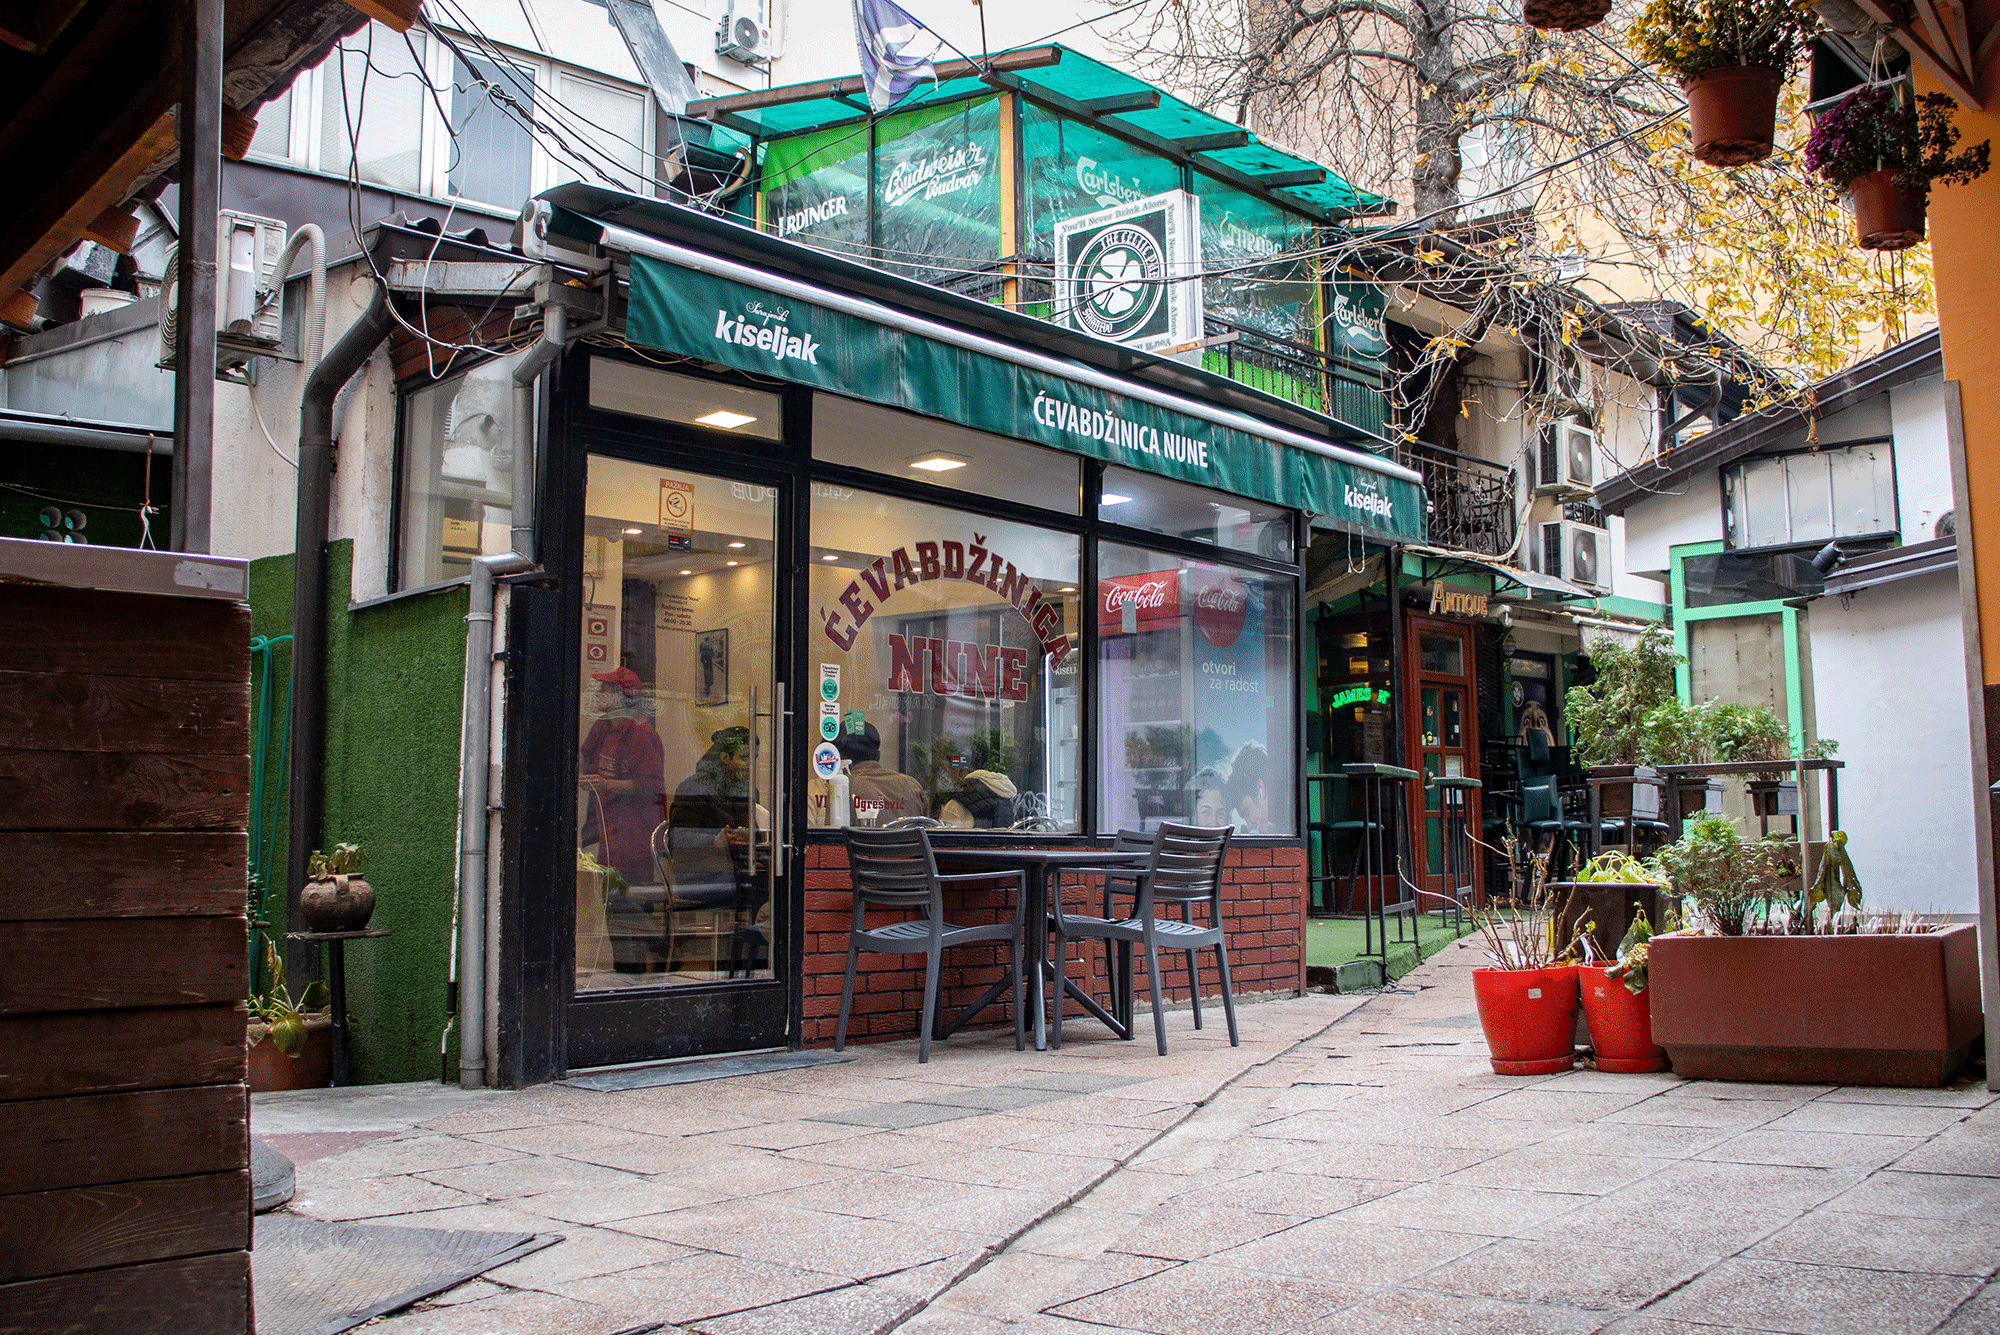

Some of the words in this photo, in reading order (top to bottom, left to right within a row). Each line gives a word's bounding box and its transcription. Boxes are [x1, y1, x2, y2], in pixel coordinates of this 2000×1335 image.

[924, 168, 984, 202] Budvar
[1076, 155, 1145, 203] Carlsber
[1088, 213, 1113, 226] Never
[1142, 198, 1168, 211] Alone
[1170, 271, 1179, 304] Dink
[715, 309, 820, 365] kiseljak
[1033, 390, 1161, 456] ĆEVABDŽINICA
[1163, 431, 1209, 468] NUNE
[1344, 484, 1393, 518] kiseljak
[819, 532, 1073, 673] ĆEVABDŽINICA
[1105, 580, 1169, 613] Coca-Cola
[1197, 585, 1241, 613] Coca-Cola
[887, 633, 1028, 702] NUNE
[1202, 661, 1236, 676] otvori
[1210, 678, 1221, 690] za
[1225, 678, 1259, 693] radost
